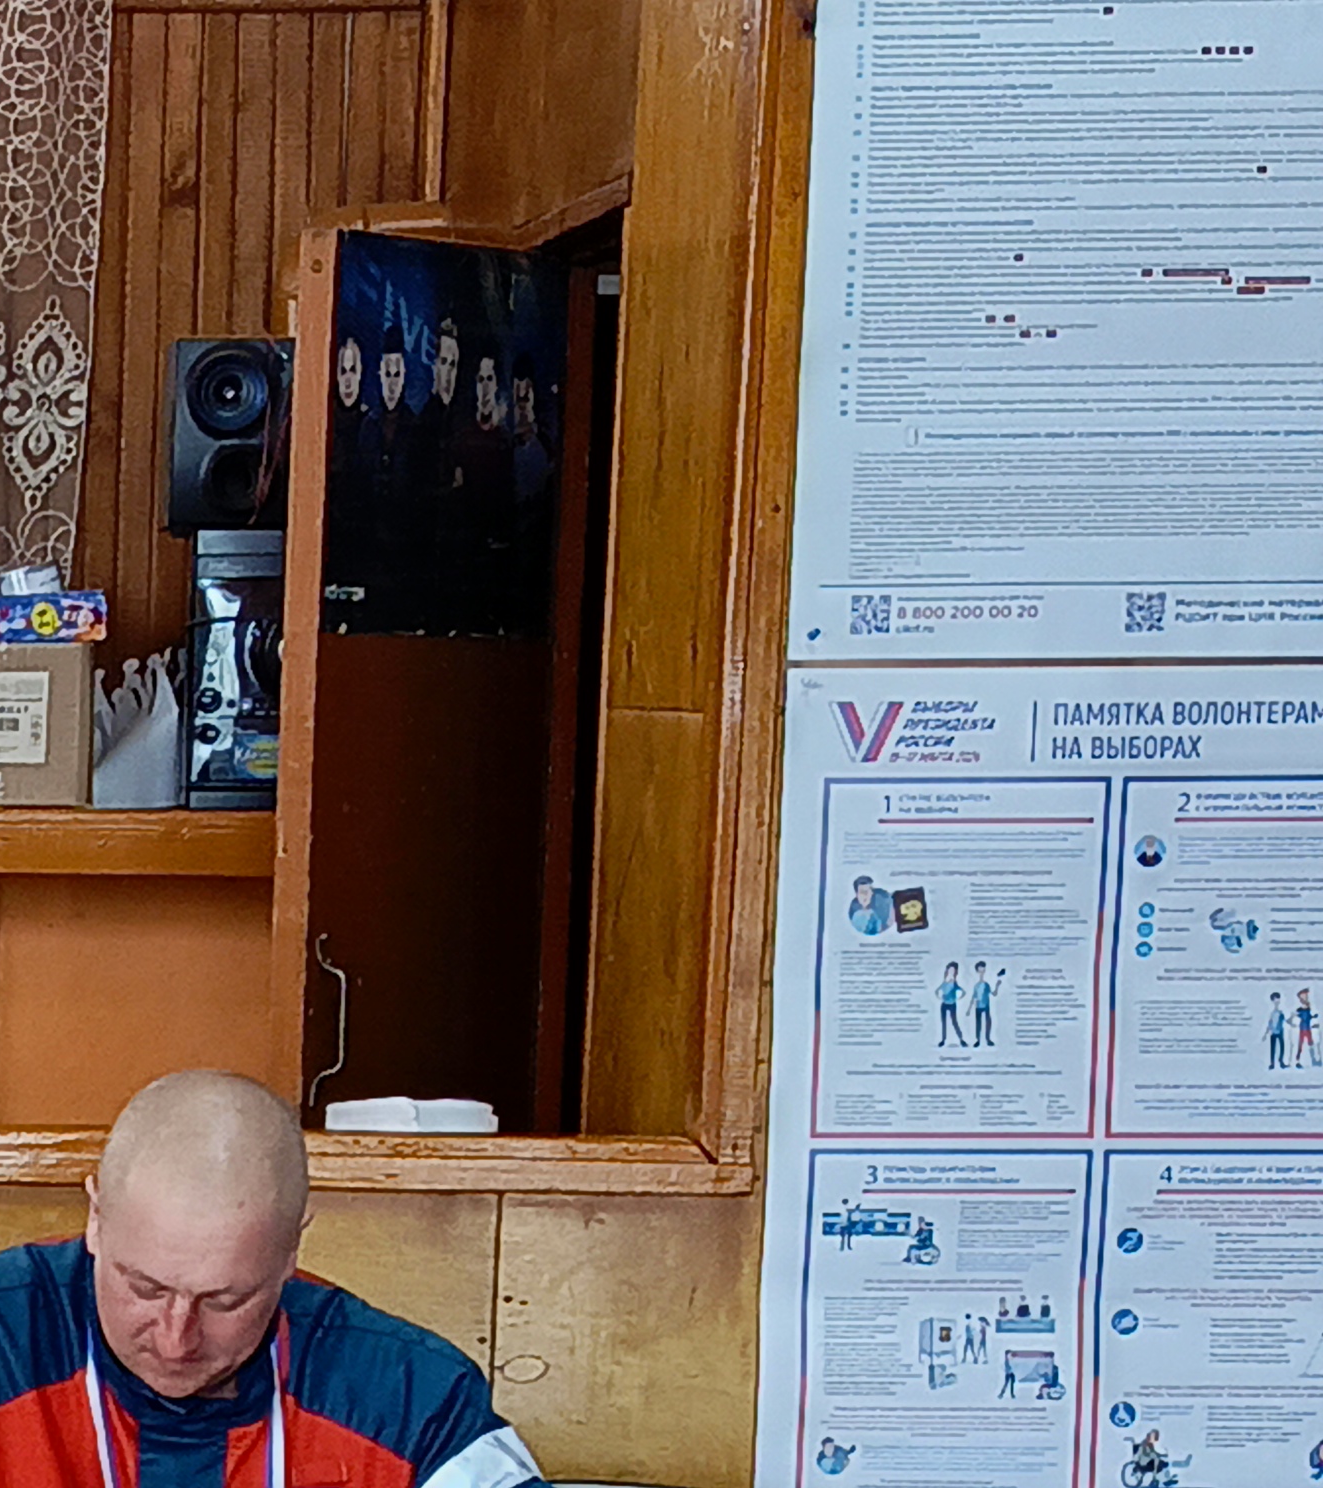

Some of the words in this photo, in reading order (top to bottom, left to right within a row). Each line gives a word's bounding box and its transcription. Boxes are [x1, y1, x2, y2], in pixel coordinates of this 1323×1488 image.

[896, 606, 907, 619] 8
[912, 606, 945, 619] 800
[950, 605, 984, 619] 200
[988, 605, 1012, 619] 00
[1017, 605, 1039, 618] 20
[1053, 702, 1165, 726] ПАМЯТКА
[1052, 736, 1082, 760] НА
[1090, 735, 1202, 760] ВЫБОРАХ
[883, 795, 891, 813] 1
[1177, 792, 1191, 812] 2
[864, 1165, 878, 1185] 3
[1159, 1165, 1173, 1184] 4
